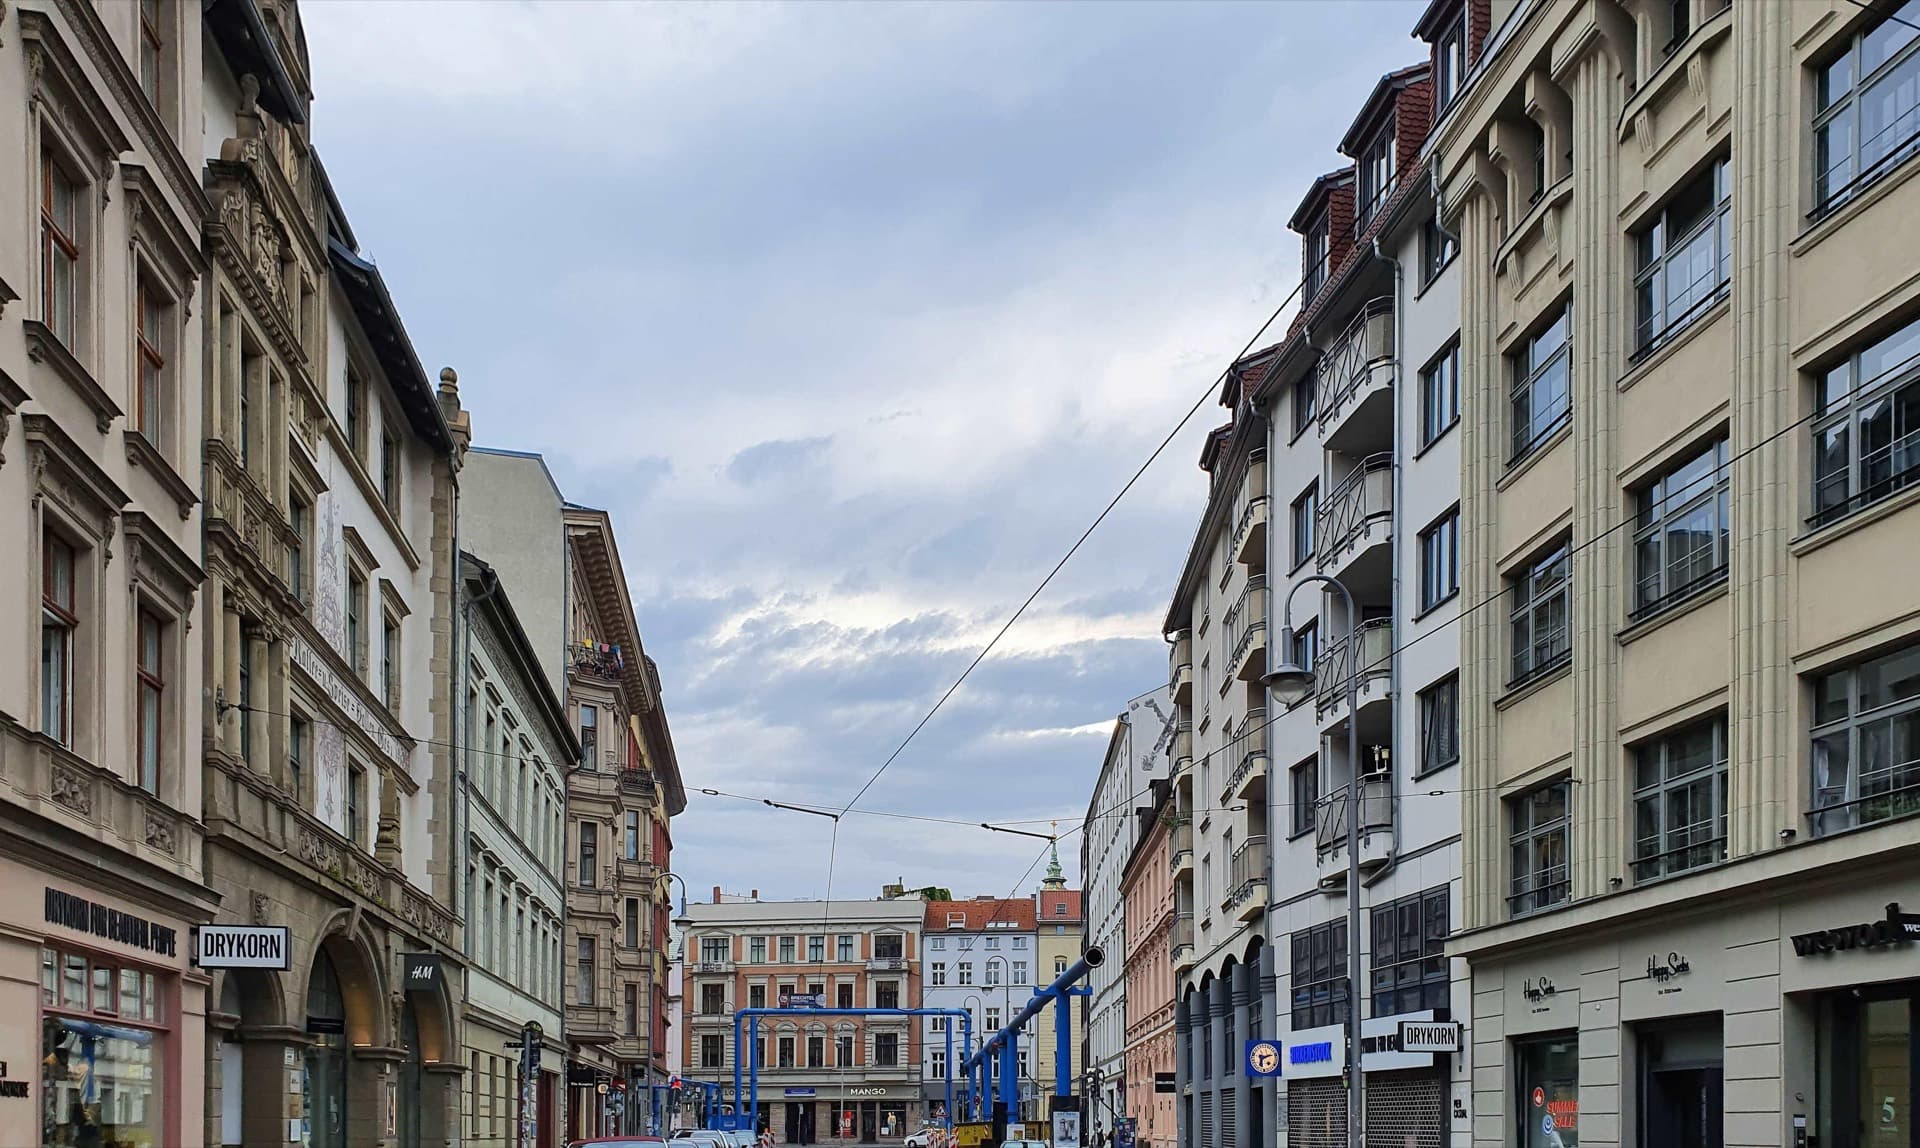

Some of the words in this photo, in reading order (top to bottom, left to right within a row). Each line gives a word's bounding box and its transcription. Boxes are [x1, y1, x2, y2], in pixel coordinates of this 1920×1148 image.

[45, 886, 89, 933] DRYKORN
[90, 902, 107, 938] FOR
[150, 922, 176, 958] PEOPLE
[204, 933, 280, 958] DRYKORN
[411, 965, 433, 980] H&M
[1646, 954, 1669, 983] Happy
[1668, 952, 1690, 976] Socks
[1523, 978, 1540, 1003] Happy
[1539, 976, 1555, 996] Socks
[1406, 1026, 1455, 1045] DRYKORN
[1290, 1041, 1332, 1065] BIRKENSTOCK
[850, 1087, 886, 1095] MANGO
[1882, 1096, 1896, 1122] 5
[1553, 1115, 1575, 1128] SALE
